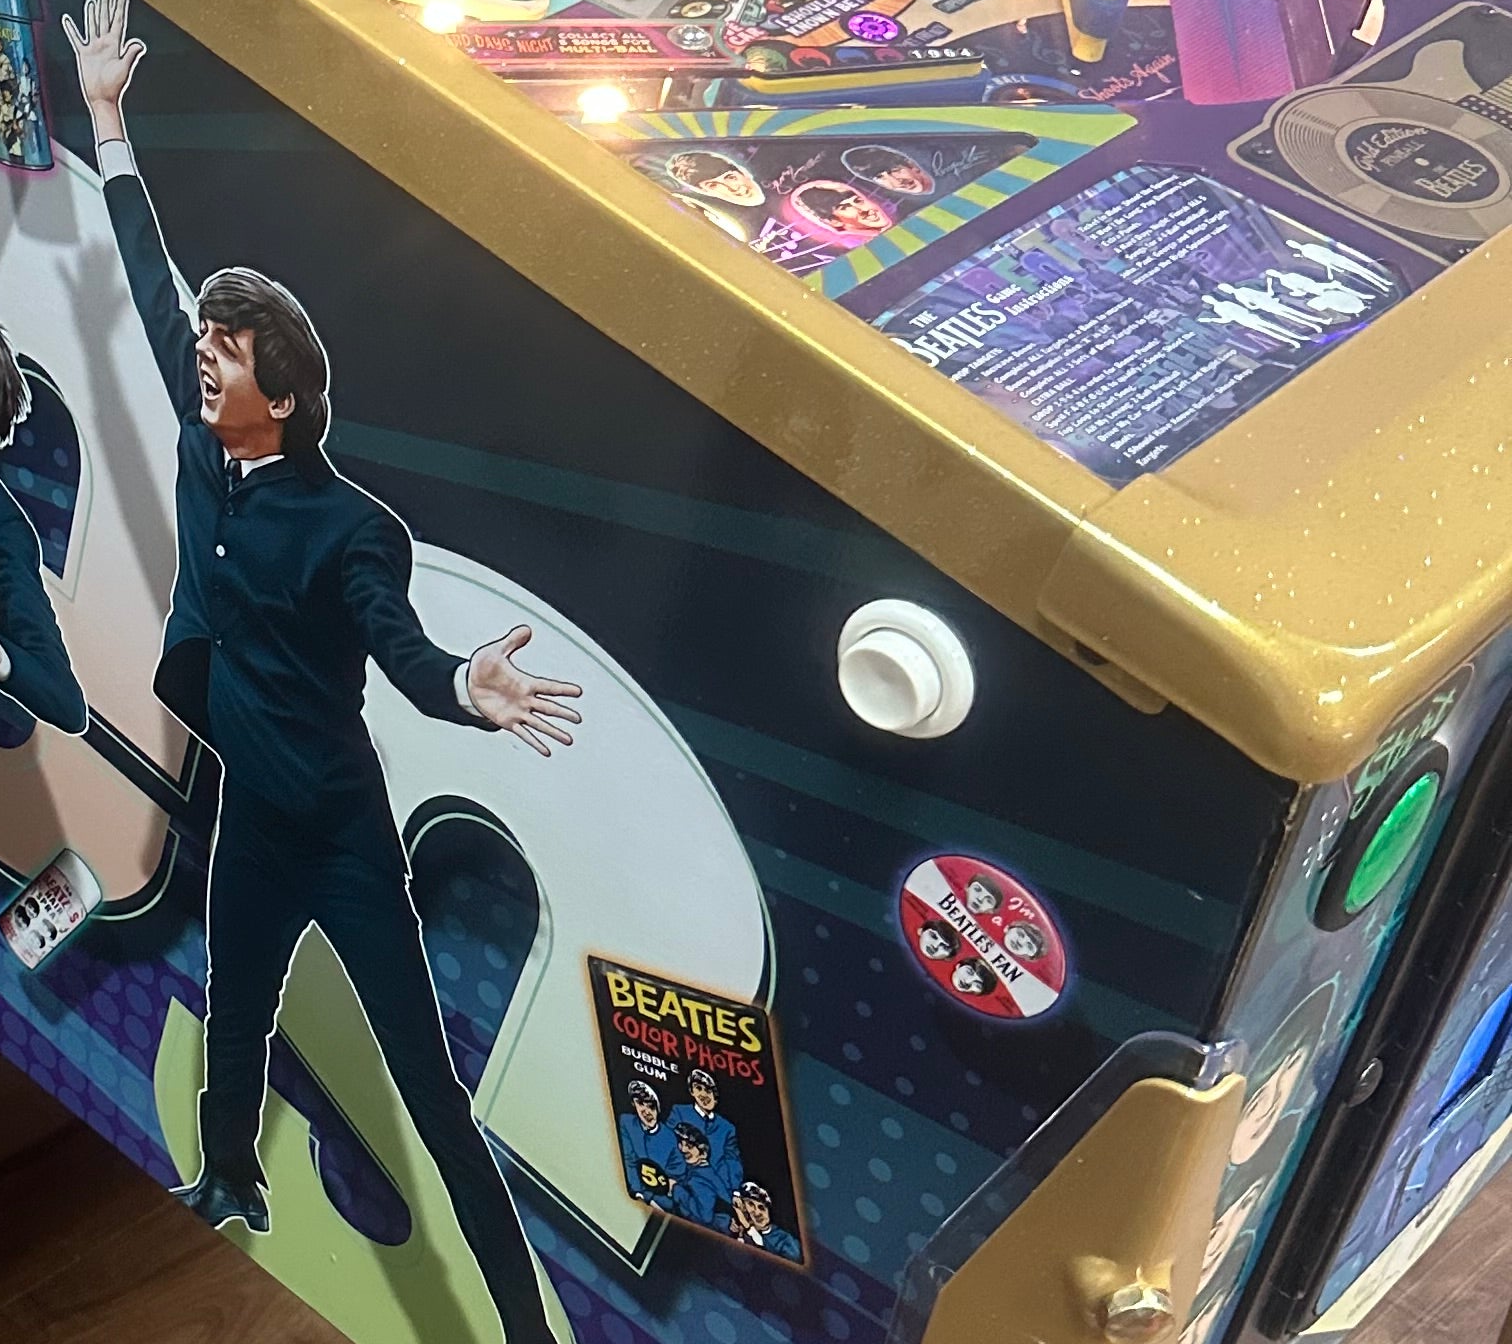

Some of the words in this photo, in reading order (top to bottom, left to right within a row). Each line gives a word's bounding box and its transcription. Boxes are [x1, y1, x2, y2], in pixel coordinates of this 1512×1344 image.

[558, 32, 618, 40] COLLECT
[786, 10, 839, 38] KNOWN
[475, 34, 514, 53] DAYS
[517, 37, 555, 54] NIGHT
[558, 46, 658, 54] MULTI-BALL
[910, 48, 974, 59] 1964
[1078, 76, 1135, 105] Shoots
[1129, 53, 1176, 86] Again
[1371, 127, 1430, 149] Edition
[1414, 159, 1488, 198] BEATLES
[986, 283, 1021, 304] Game
[1004, 275, 1075, 316] Instructions
[909, 310, 939, 328] THE
[889, 301, 1007, 368] BEATLES
[1349, 687, 1457, 820] Start
[937, 892, 995, 955] BEATLES
[991, 915, 1004, 928] a
[990, 953, 1025, 984] FAN
[606, 971, 762, 1053] BEATLES
[612, 1011, 680, 1058] COLOR
[684, 1034, 765, 1086] PHOTOS
[621, 1044, 680, 1074] BUBBLE
[633, 1060, 668, 1082] GUM
